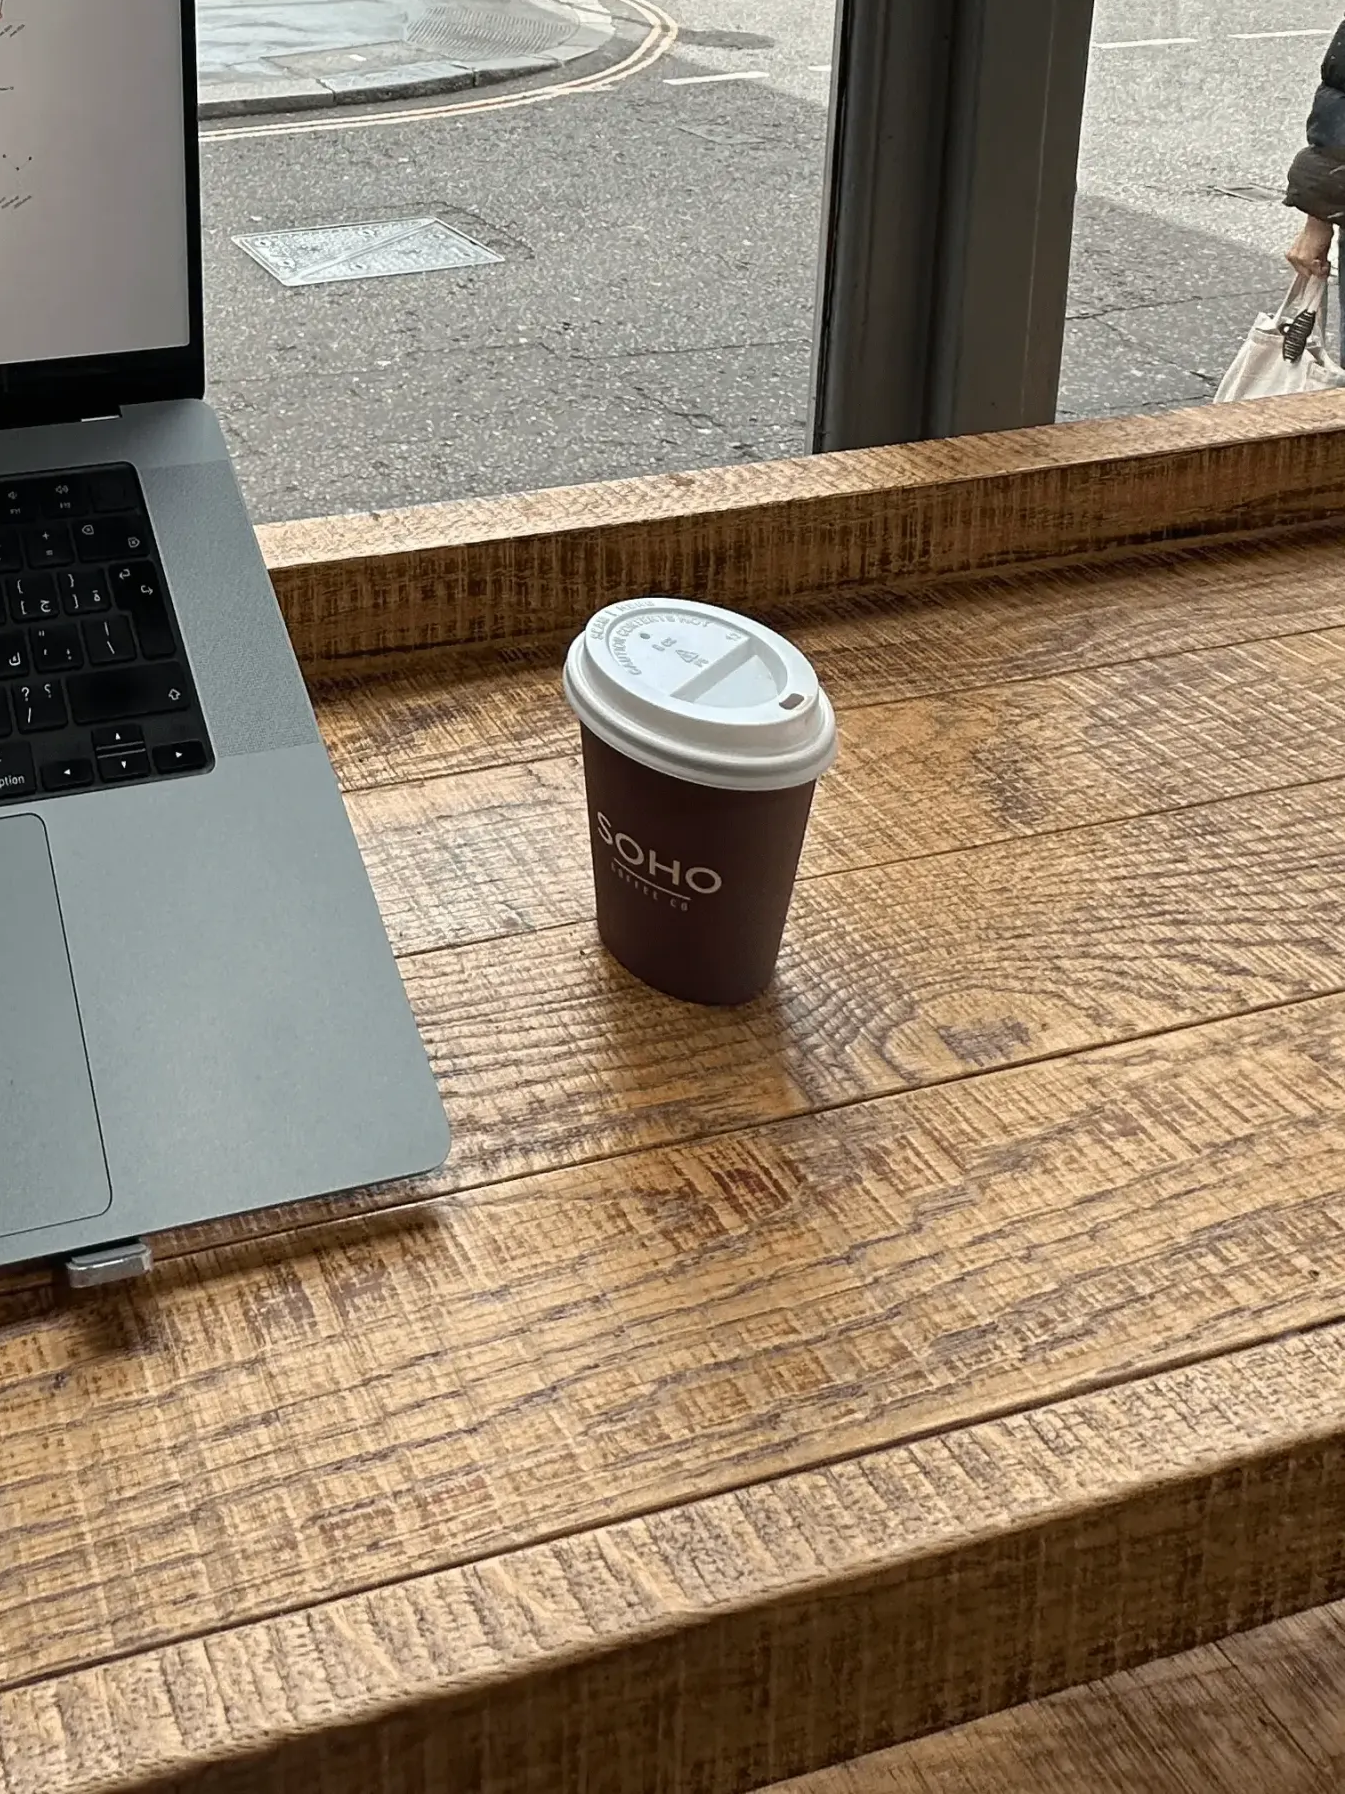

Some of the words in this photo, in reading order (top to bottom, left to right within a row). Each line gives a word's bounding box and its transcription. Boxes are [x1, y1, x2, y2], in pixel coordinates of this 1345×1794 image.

[616, 614, 677, 637] CONTENTS
[611, 636, 643, 676] CAUTION
[22, 687, 29, 701] ?
[597, 811, 723, 894] SOHO
